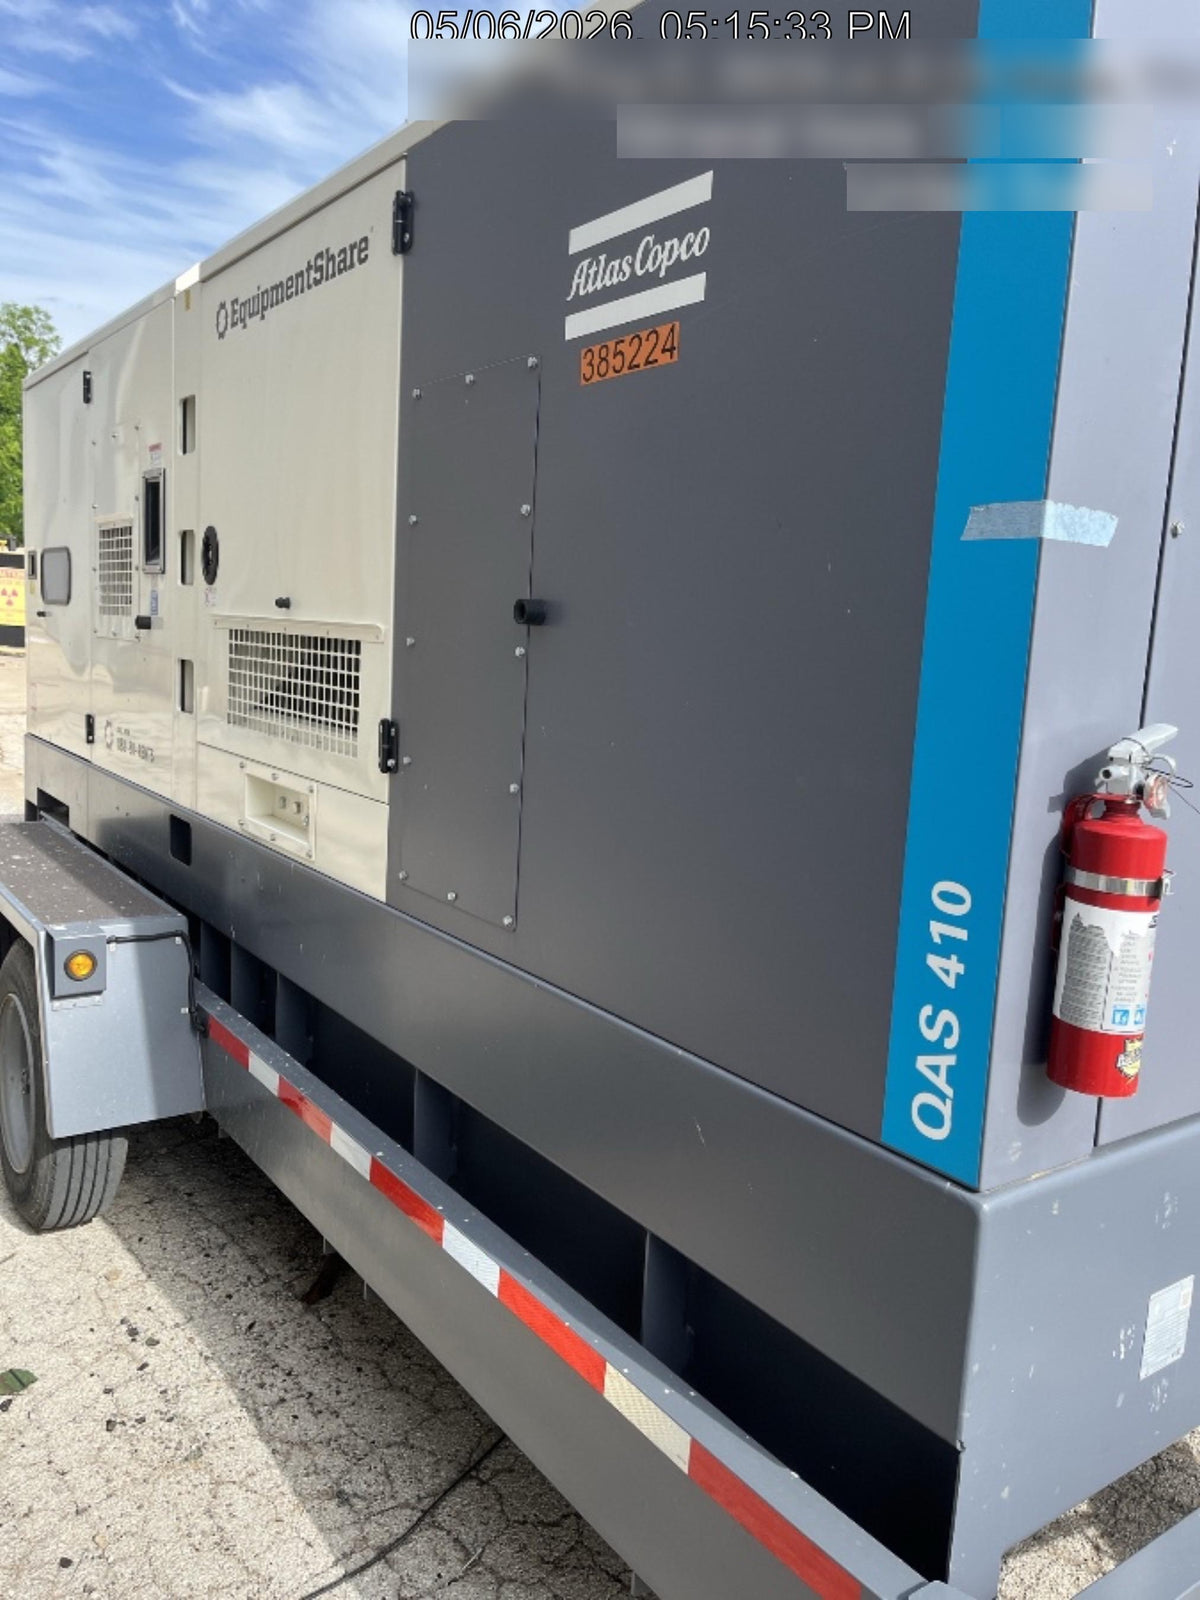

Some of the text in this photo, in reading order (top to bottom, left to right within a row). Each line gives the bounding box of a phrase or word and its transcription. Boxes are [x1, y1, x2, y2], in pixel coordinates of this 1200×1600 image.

[230, 235, 369, 329] EquipmentShare
[566, 226, 711, 301] Atlas Copco
[582, 322, 677, 383] 385224
[911, 880, 972, 1141] QAS 410
